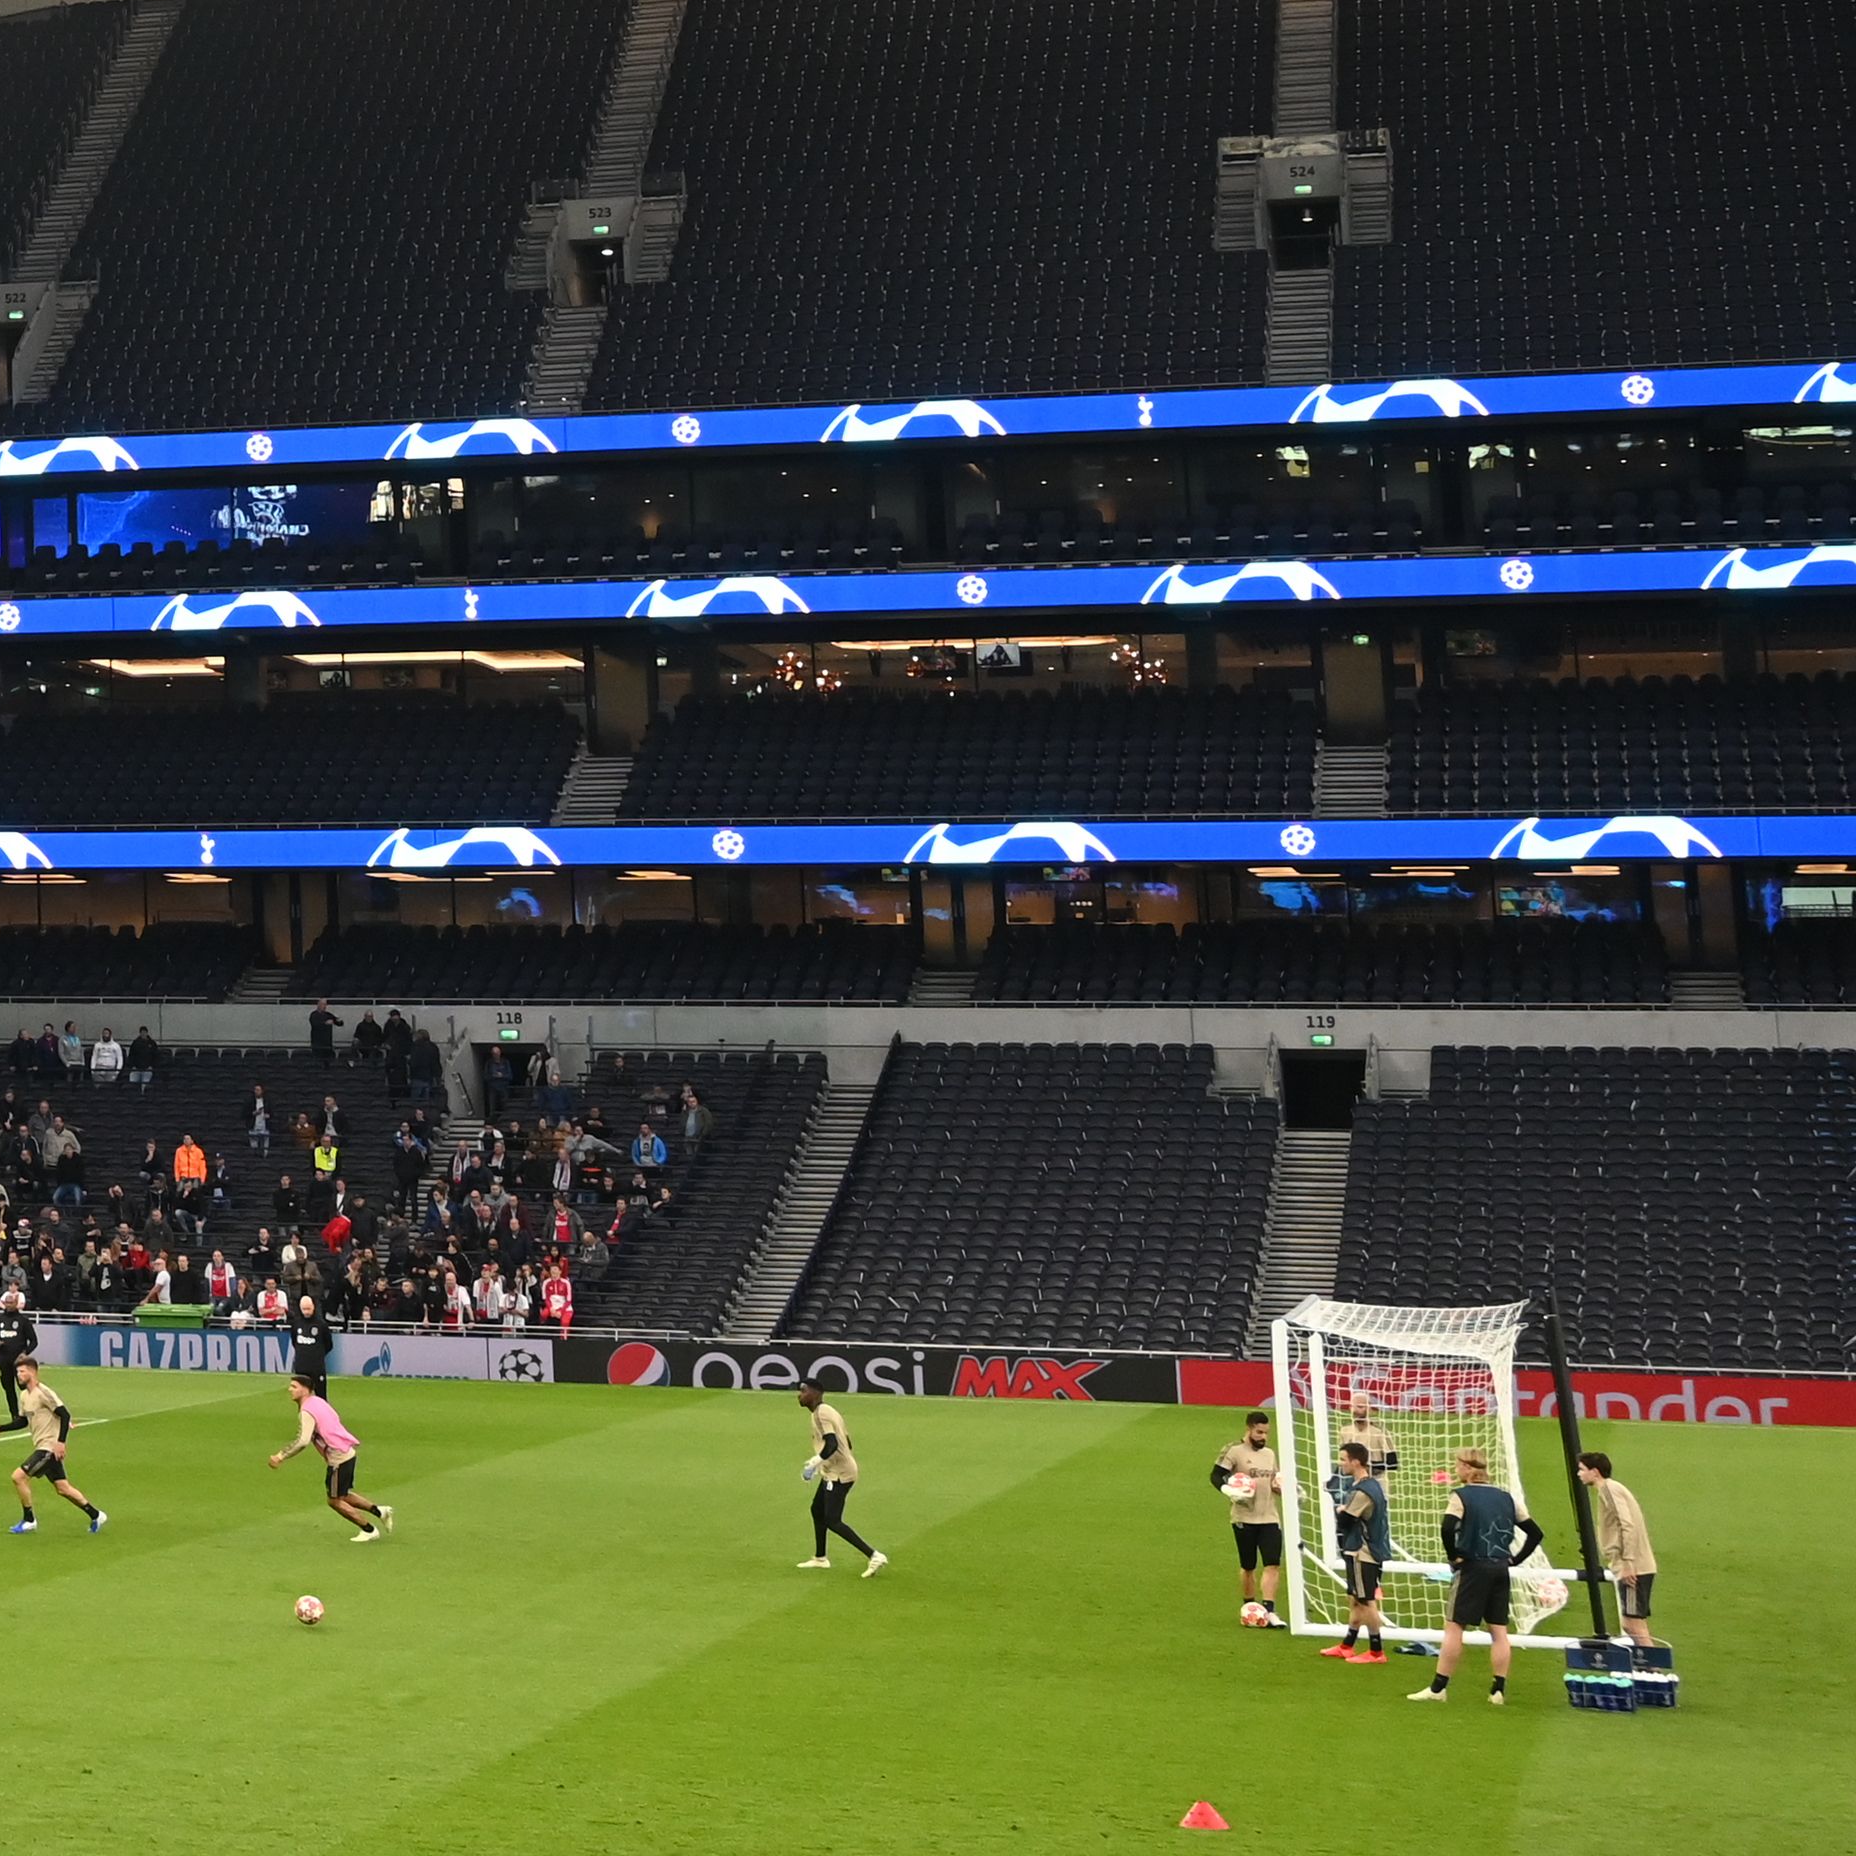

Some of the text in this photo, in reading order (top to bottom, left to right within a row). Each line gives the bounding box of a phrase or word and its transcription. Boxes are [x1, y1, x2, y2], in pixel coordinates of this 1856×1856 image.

[1290, 166, 1315, 178] 524
[588, 207, 610, 218] 523
[5, 292, 27, 304] 522
[496, 1012, 522, 1027] 118
[1306, 1016, 1336, 1029] 119
[950, 1354, 1114, 1402] MAX
